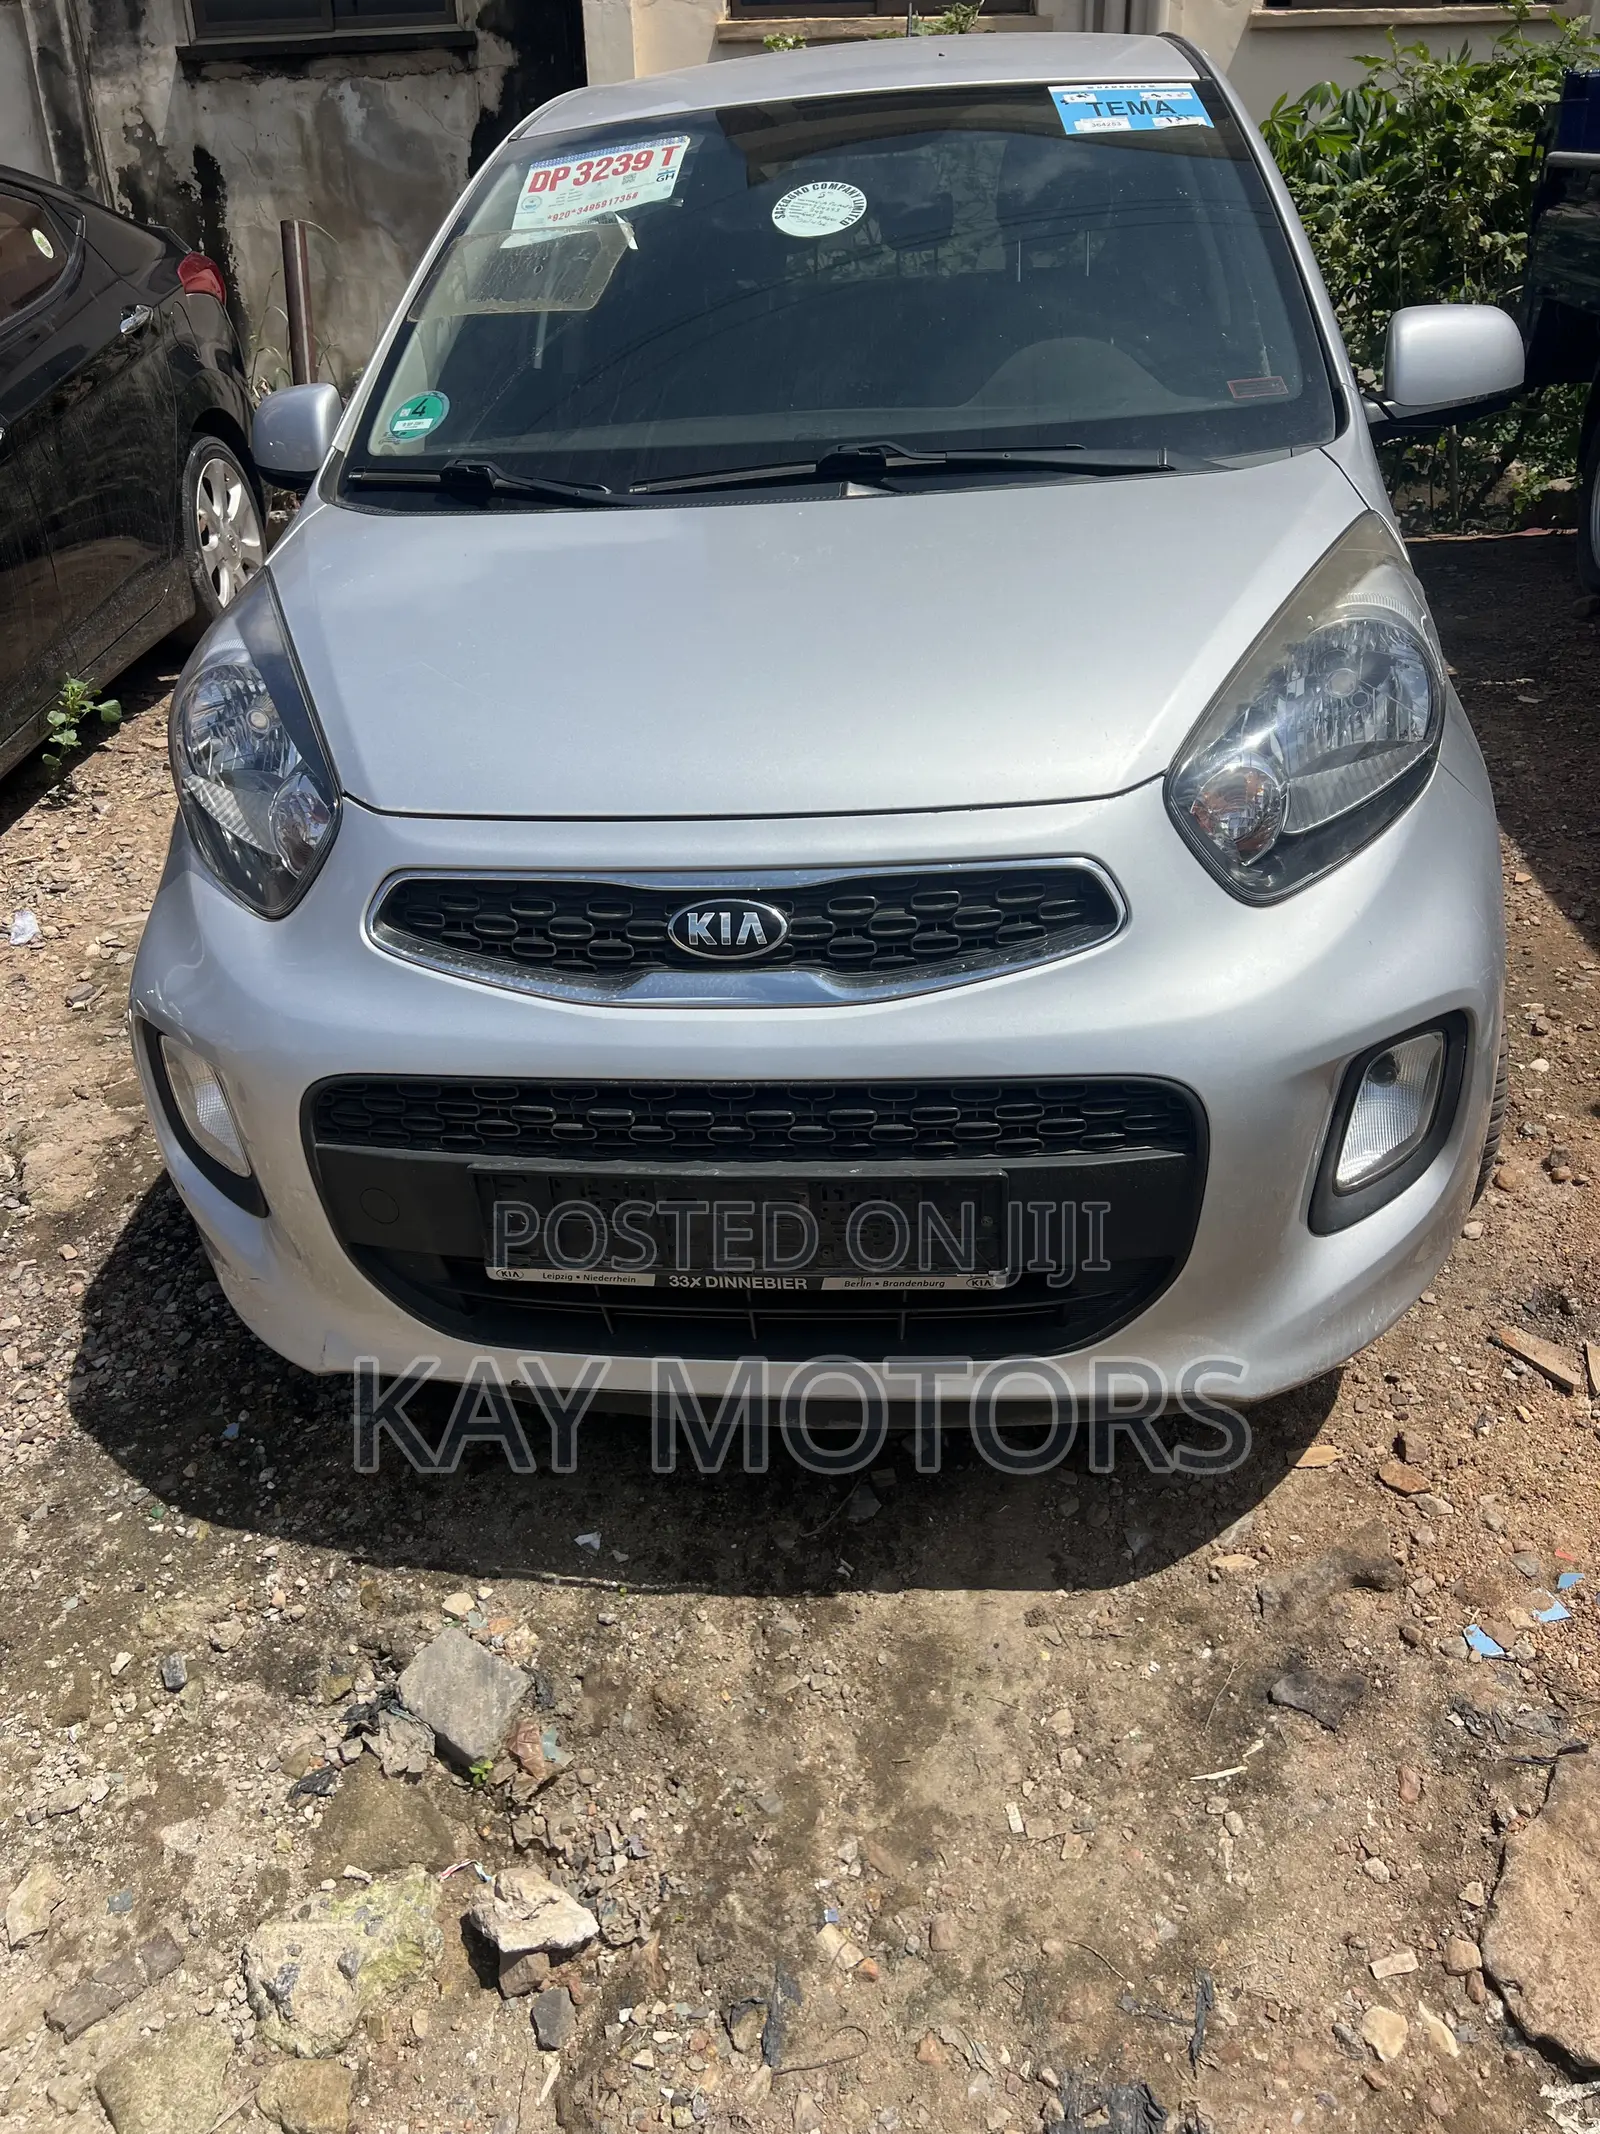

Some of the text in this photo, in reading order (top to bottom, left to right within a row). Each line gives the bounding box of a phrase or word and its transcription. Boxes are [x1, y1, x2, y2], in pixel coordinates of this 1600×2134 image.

[1085, 100, 1177, 117] TEMA
[528, 166, 571, 193] DP
[572, 150, 655, 187] 3239
[661, 145, 681, 167] T
[656, 173, 675, 183] GH
[812, 183, 861, 198] COMPANY
[840, 199, 864, 225] LIMITED
[411, 398, 429, 417] 4
[687, 911, 768, 946] KIA
[542, 1272, 573, 1282] Leipzig
[583, 1274, 637, 1283] Niederrhein
[705, 1276, 808, 1290] DINNEBIER
[843, 1279, 872, 1288] Berlin
[882, 1279, 946, 1289] Brandenburg
